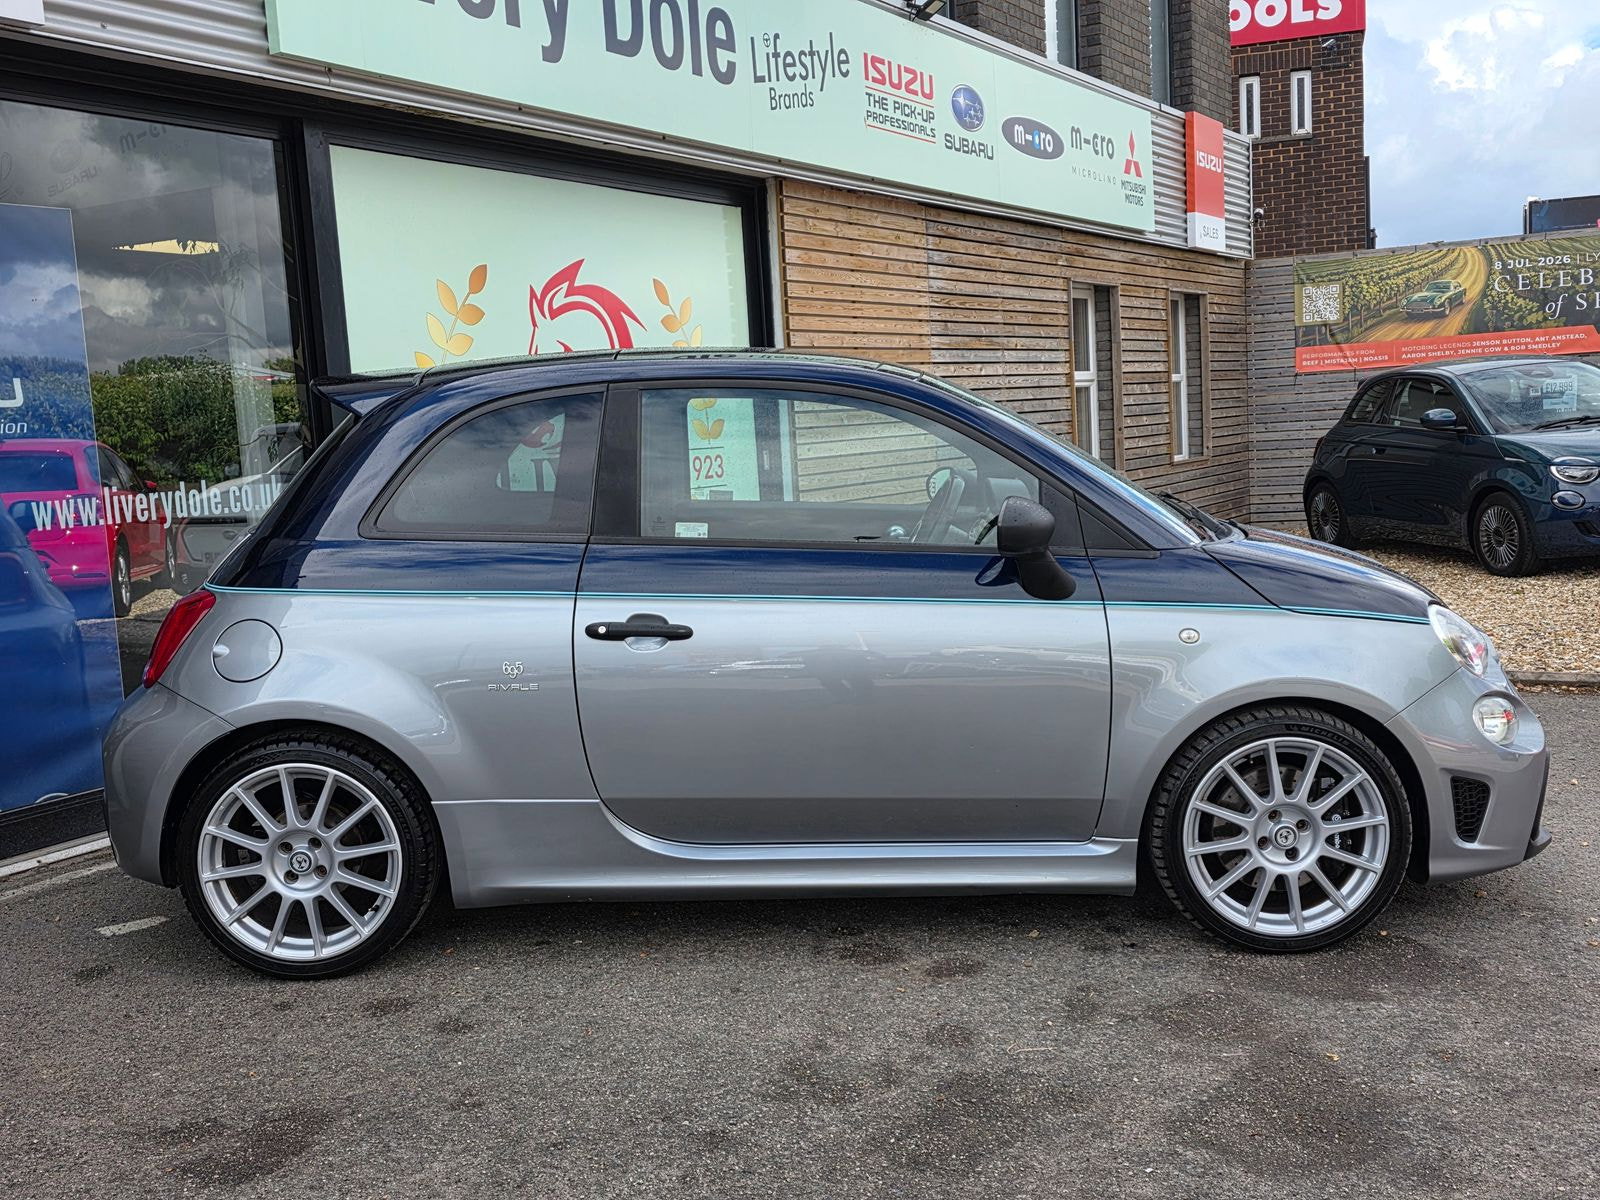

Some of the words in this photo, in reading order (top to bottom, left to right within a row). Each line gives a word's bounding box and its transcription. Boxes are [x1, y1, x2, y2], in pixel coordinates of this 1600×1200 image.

[603, 0, 737, 85] Dole
[750, 32, 850, 92] Lifestyle
[863, 52, 935, 100] ISUZU
[769, 83, 815, 110] Brands
[865, 92, 888, 111] THE
[893, 99, 935, 123] PICK-UP
[866, 110, 936, 138] PROFESSIONALS
[944, 133, 994, 160] SUBARU
[1196, 150, 1222, 173] ISUZU
[1120, 179, 1147, 195] MITSUBISHI
[1124, 193, 1144, 206] MOTORS
[1202, 225, 1219, 239] SALES
[1494, 261, 1503, 270] 8
[1507, 258, 1532, 269] JUL
[1538, 255, 1571, 266] 2026
[1494, 268, 1594, 292] CELEB
[1545, 293, 1568, 320] of
[1402, 343, 1438, 352] MOTORING
[1440, 341, 1471, 349] LEGENDS
[1472, 339, 1500, 347] JENSON
[1402, 351, 1426, 359] AARON
[1527, 342, 1561, 350] SMEDLEY
[692, 454, 725, 481] 923
[31, 474, 282, 532] www.liverydole.co.uk
[488, 683, 540, 691] RIVALE
